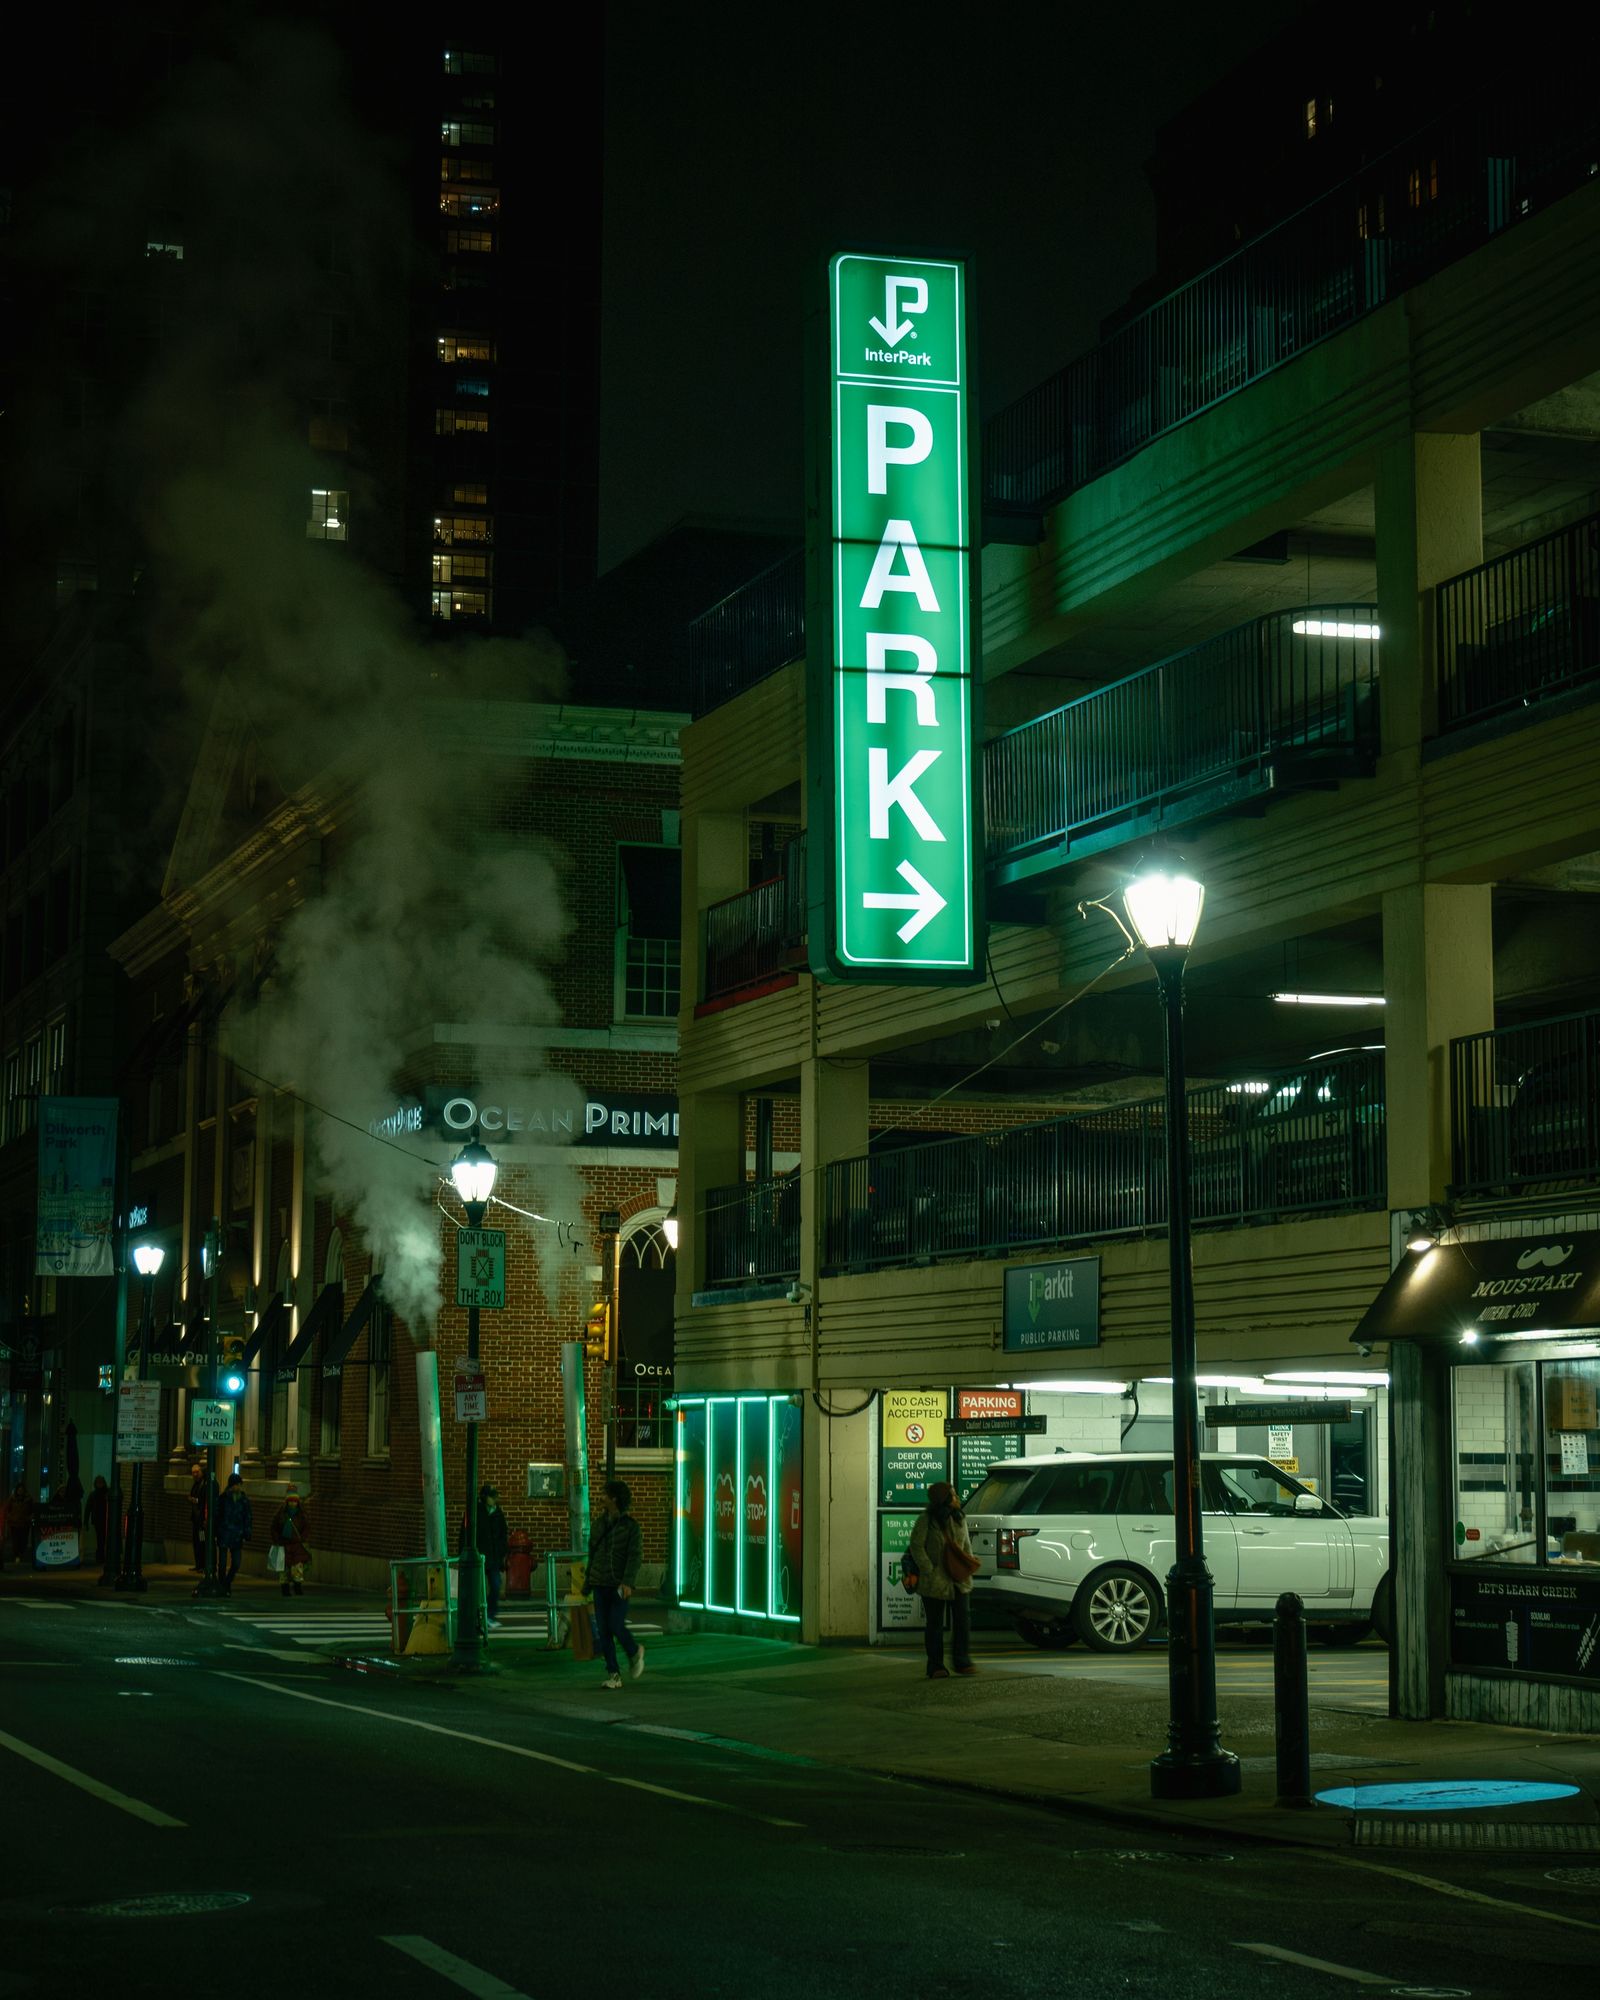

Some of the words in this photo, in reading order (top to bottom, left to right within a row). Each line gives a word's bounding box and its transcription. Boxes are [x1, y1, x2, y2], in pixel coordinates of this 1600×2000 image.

[864, 347, 932, 367] InterPark
[859, 403, 948, 842] PARK
[44, 1122, 106, 1136] Dilworth
[45, 1137, 79, 1149] Park
[481, 1233, 504, 1248] BLOCK
[1471, 1272, 1582, 1298] MOUSTAKI
[460, 1288, 480, 1304] THE
[484, 1290, 502, 1306] BOX
[1020, 1331, 1046, 1345] PUBLIC
[1047, 1328, 1080, 1342] PARKING
[464, 1393, 478, 1402] ANY
[892, 1397, 907, 1406] NO
[910, 1397, 938, 1406] CASH
[962, 1397, 1017, 1409] PARKING
[205, 1405, 222, 1414] NO
[463, 1402, 480, 1411] TIME
[887, 1409, 943, 1419] ACCEPTED
[199, 1417, 228, 1427] TURN
[213, 1431, 231, 1441] RED
[887, 1462, 915, 1470] CREDIT
[916, 1462, 943, 1470] CARDS
[747, 1503, 764, 1520] STOP
[886, 1520, 901, 1528] 15th
[902, 1520, 908, 1528] &
[1478, 1583, 1505, 1595] LET'S
[1506, 1584, 1540, 1597] LEARN
[1541, 1586, 1577, 1598] GREEK
